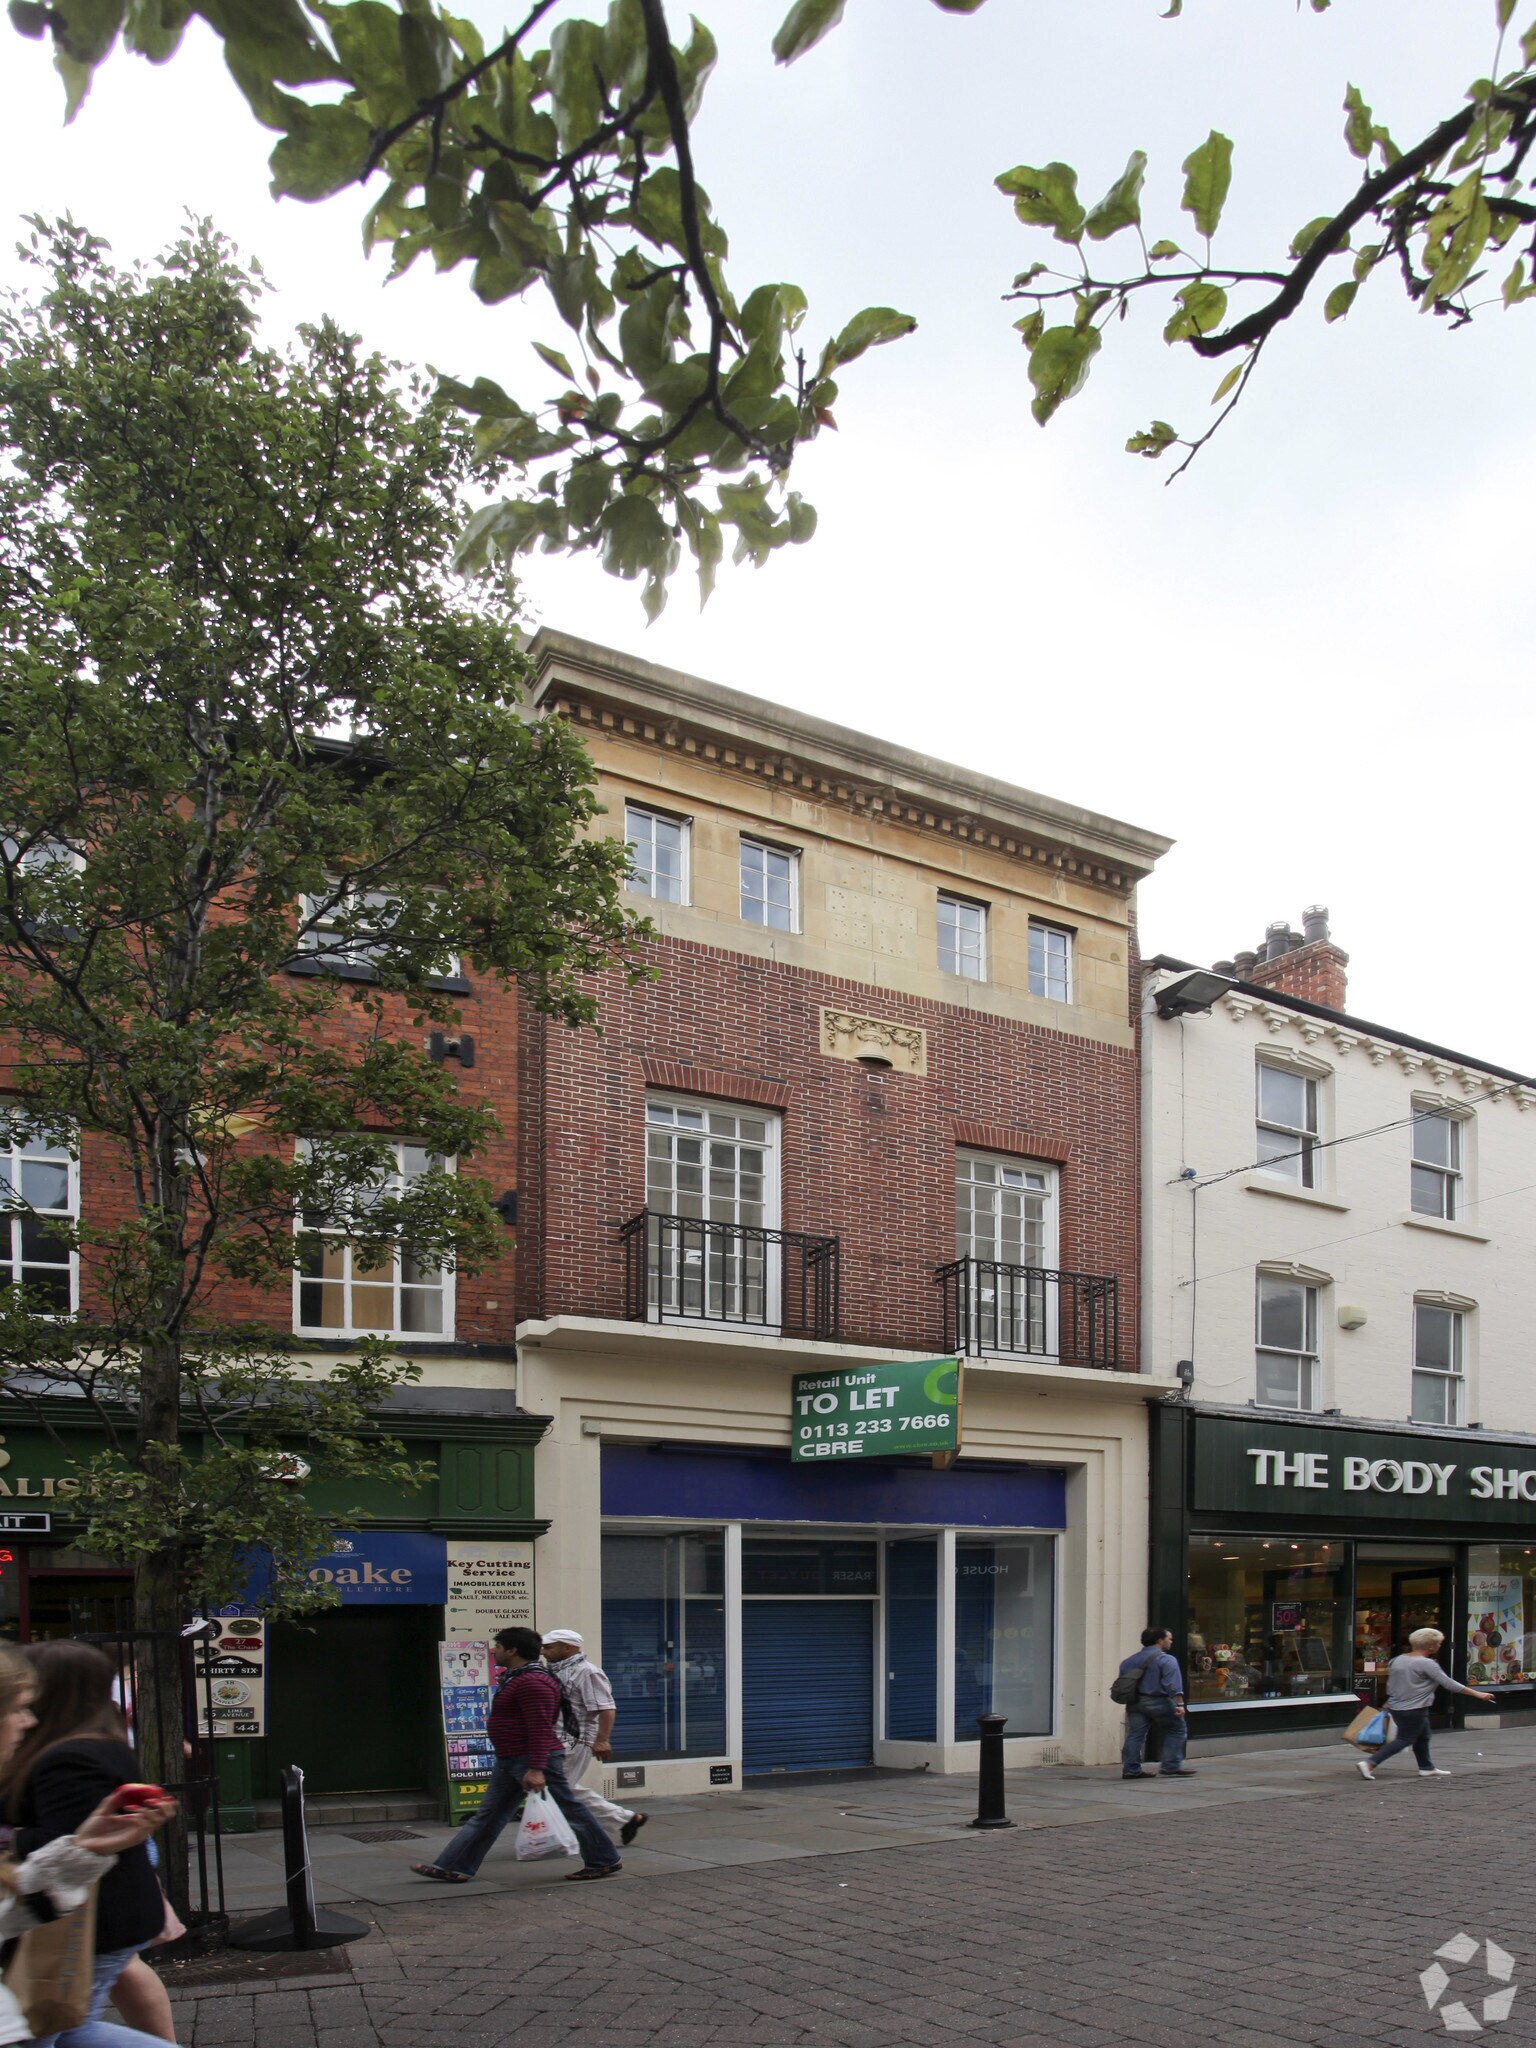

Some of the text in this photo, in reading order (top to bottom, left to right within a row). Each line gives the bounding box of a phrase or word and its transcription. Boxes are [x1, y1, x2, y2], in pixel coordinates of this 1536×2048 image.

[798, 1373, 876, 1391] Retail Unit
[796, 1386, 900, 1416] TO LET
[800, 1413, 950, 1440] 0113 233 7666
[798, 1440, 864, 1457] CBRE
[1247, 1448, 1329, 1489] THE
[1343, 1456, 1457, 1496] BODY
[0, 1516, 26, 1528] IT
[277, 1562, 413, 1584] oake
[447, 1560, 531, 1569] Key Cutting
[462, 1568, 516, 1576] Service
